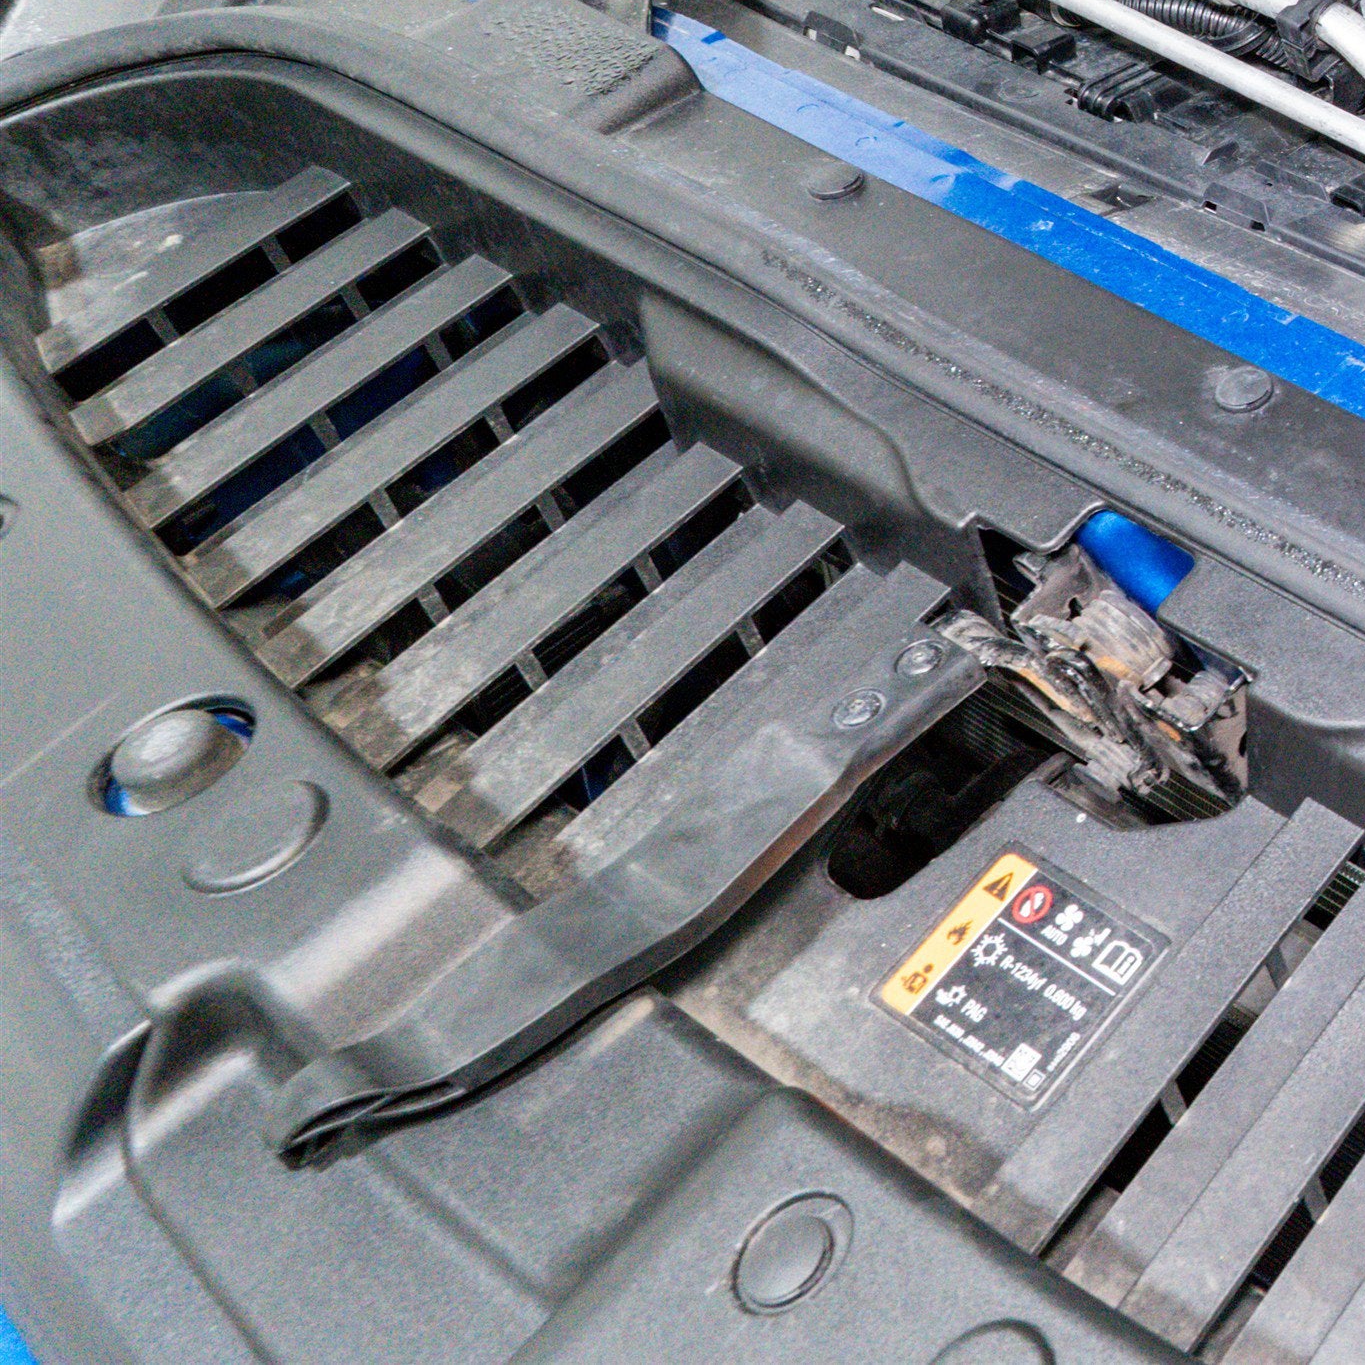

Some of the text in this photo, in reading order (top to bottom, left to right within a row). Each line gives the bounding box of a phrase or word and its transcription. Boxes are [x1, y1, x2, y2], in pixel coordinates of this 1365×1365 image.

[1041, 925, 1068, 946] AUTO
[1000, 955, 1048, 991] R-1234yf
[1068, 1000, 1088, 1022] kg
[960, 998, 989, 1023] PAG
